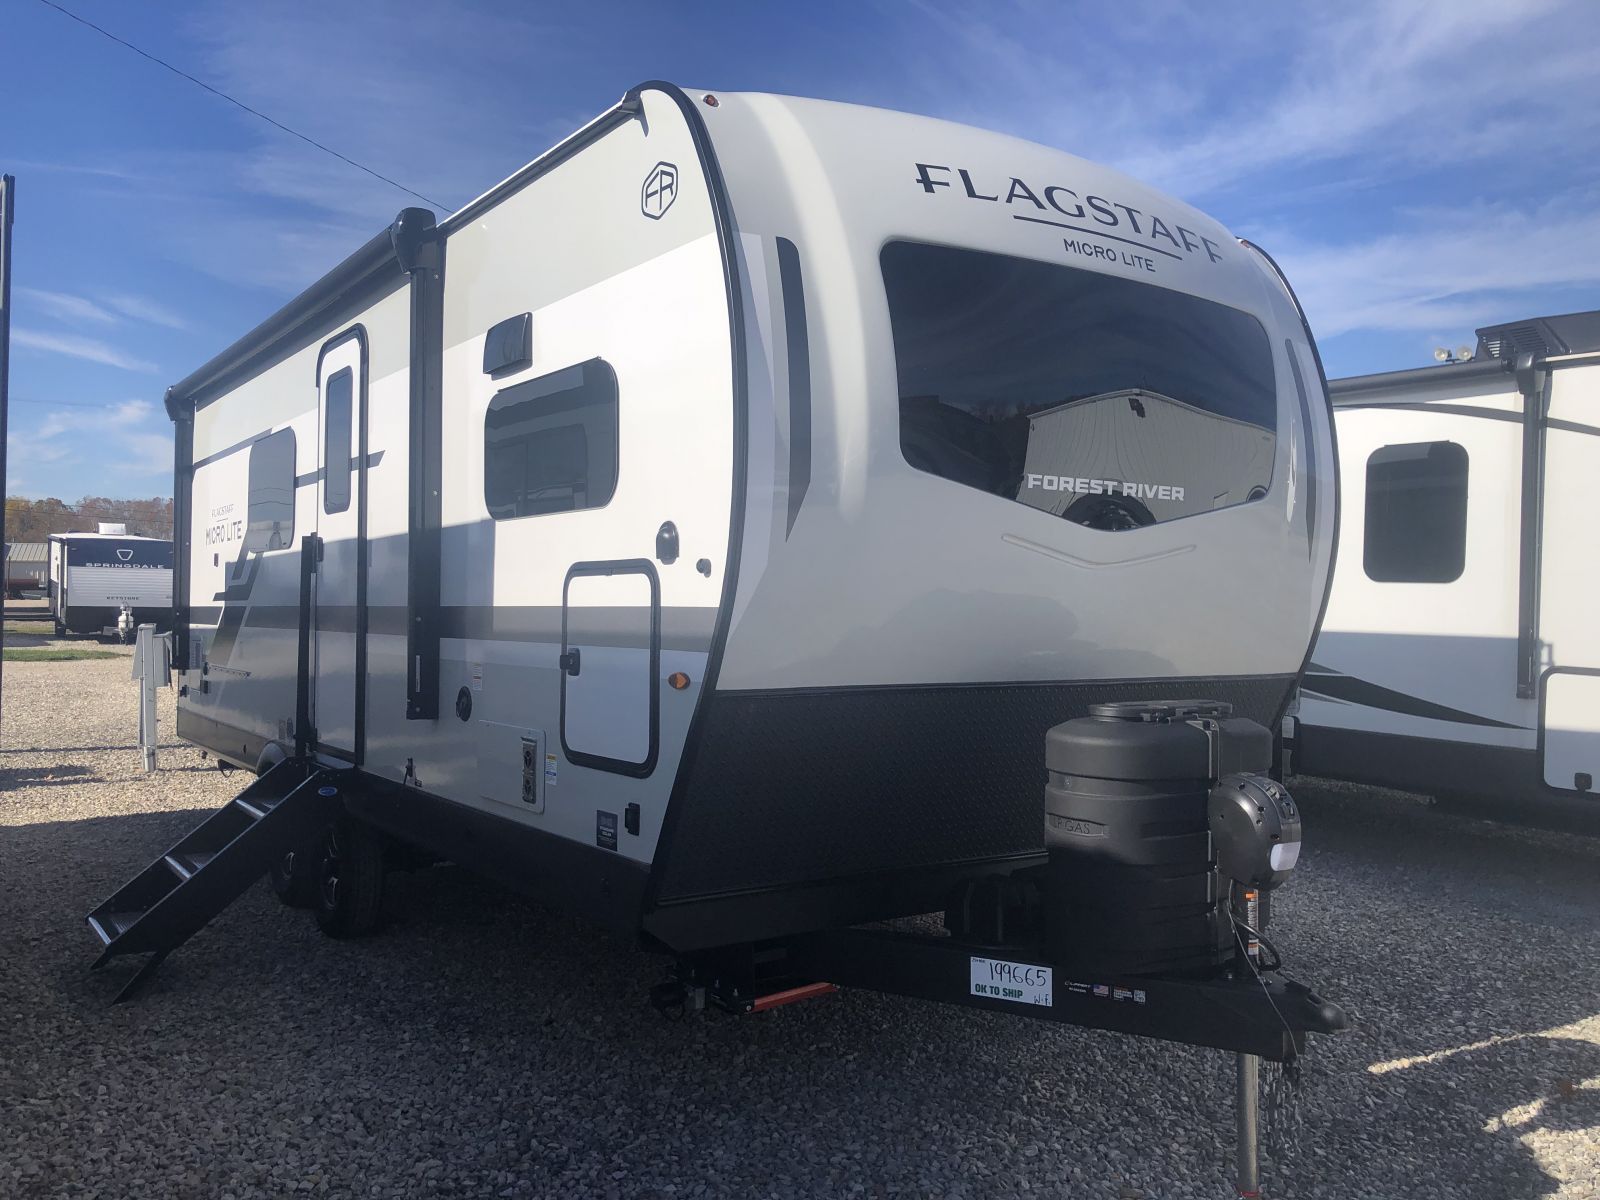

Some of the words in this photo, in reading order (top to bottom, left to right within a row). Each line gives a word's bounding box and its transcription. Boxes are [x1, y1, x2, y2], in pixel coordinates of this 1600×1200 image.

[914, 162, 1223, 264] FLAGSTAFF
[1063, 238, 1118, 262] MICRO
[1122, 251, 1156, 272] LITE
[1027, 473, 1118, 496] FOREST
[1122, 482, 1185, 501] RIVER
[211, 503, 234, 518] FLAGSTAFF
[205, 524, 225, 547] MICRO
[226, 520, 242, 541] LITE
[1064, 820, 1090, 834] GAS
[989, 961, 1047, 987] 199665
[975, 983, 988, 994] OK
[989, 985, 1000, 996] TO
[1002, 987, 1023, 999] SHIP
